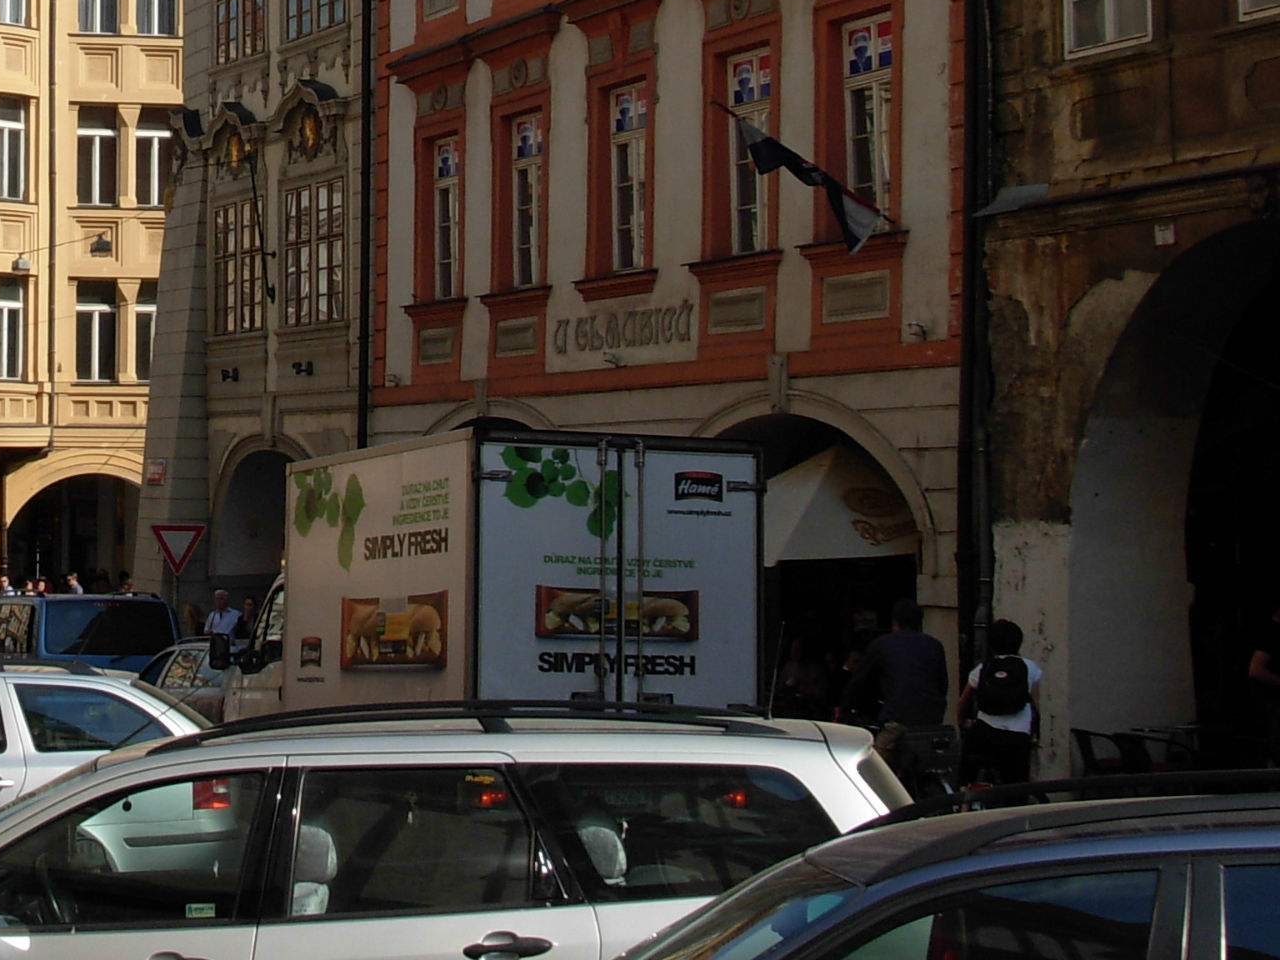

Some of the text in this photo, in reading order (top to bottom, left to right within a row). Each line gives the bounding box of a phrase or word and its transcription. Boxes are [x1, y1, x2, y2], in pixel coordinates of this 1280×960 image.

[364, 527, 449, 561] SIMPLY FRESH
[537, 652, 696, 676] SIMPLY FRESH
